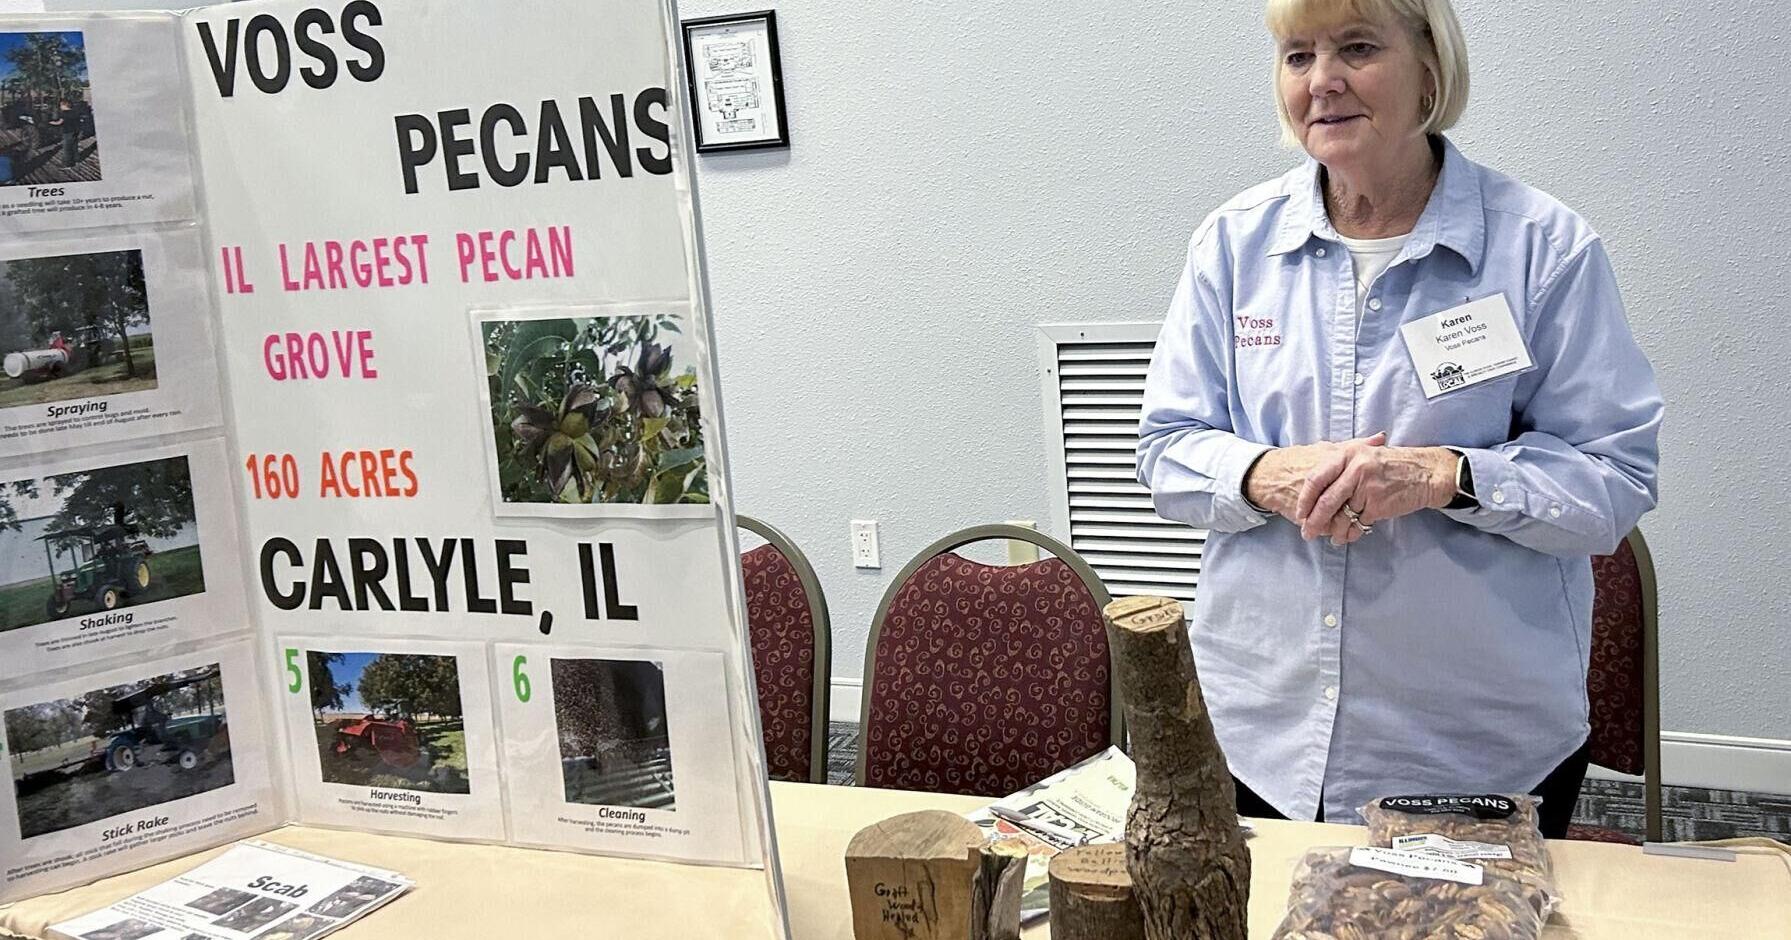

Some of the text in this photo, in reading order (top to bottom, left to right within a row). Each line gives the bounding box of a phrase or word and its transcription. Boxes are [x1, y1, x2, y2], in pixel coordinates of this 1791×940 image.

[196, 0, 386, 98] VOSS
[394, 87, 674, 195] PECANS
[28, 186, 65, 198] Trees
[7, 208, 31, 216] grafted
[221, 226, 574, 294] IL LARGEST PECAN
[1237, 316, 1274, 329] Voss
[1441, 313, 1472, 329] Karen
[1435, 322, 1488, 344] Karen Voss
[1234, 335, 1281, 349] Pecans
[1444, 334, 1486, 351] Voss Pecans
[263, 330, 377, 381] GROVE
[47, 401, 107, 418] Spraying
[48, 418, 72, 426] sprayed
[114, 416, 136, 424] August
[246, 449, 419, 499] 160 ACRES
[260, 537, 639, 635] CARLYLE, IL
[80, 612, 133, 631] Shaking
[285, 648, 302, 694] 5
[512, 654, 530, 703] 6
[370, 788, 421, 805] Harvesting
[1385, 798, 1432, 806] VOSS
[1437, 796, 1511, 811] PECANS
[599, 807, 646, 823] Cleaning
[102, 816, 169, 842] Stick Rake
[248, 875, 309, 899] Scab
[874, 882, 908, 899] Graft
